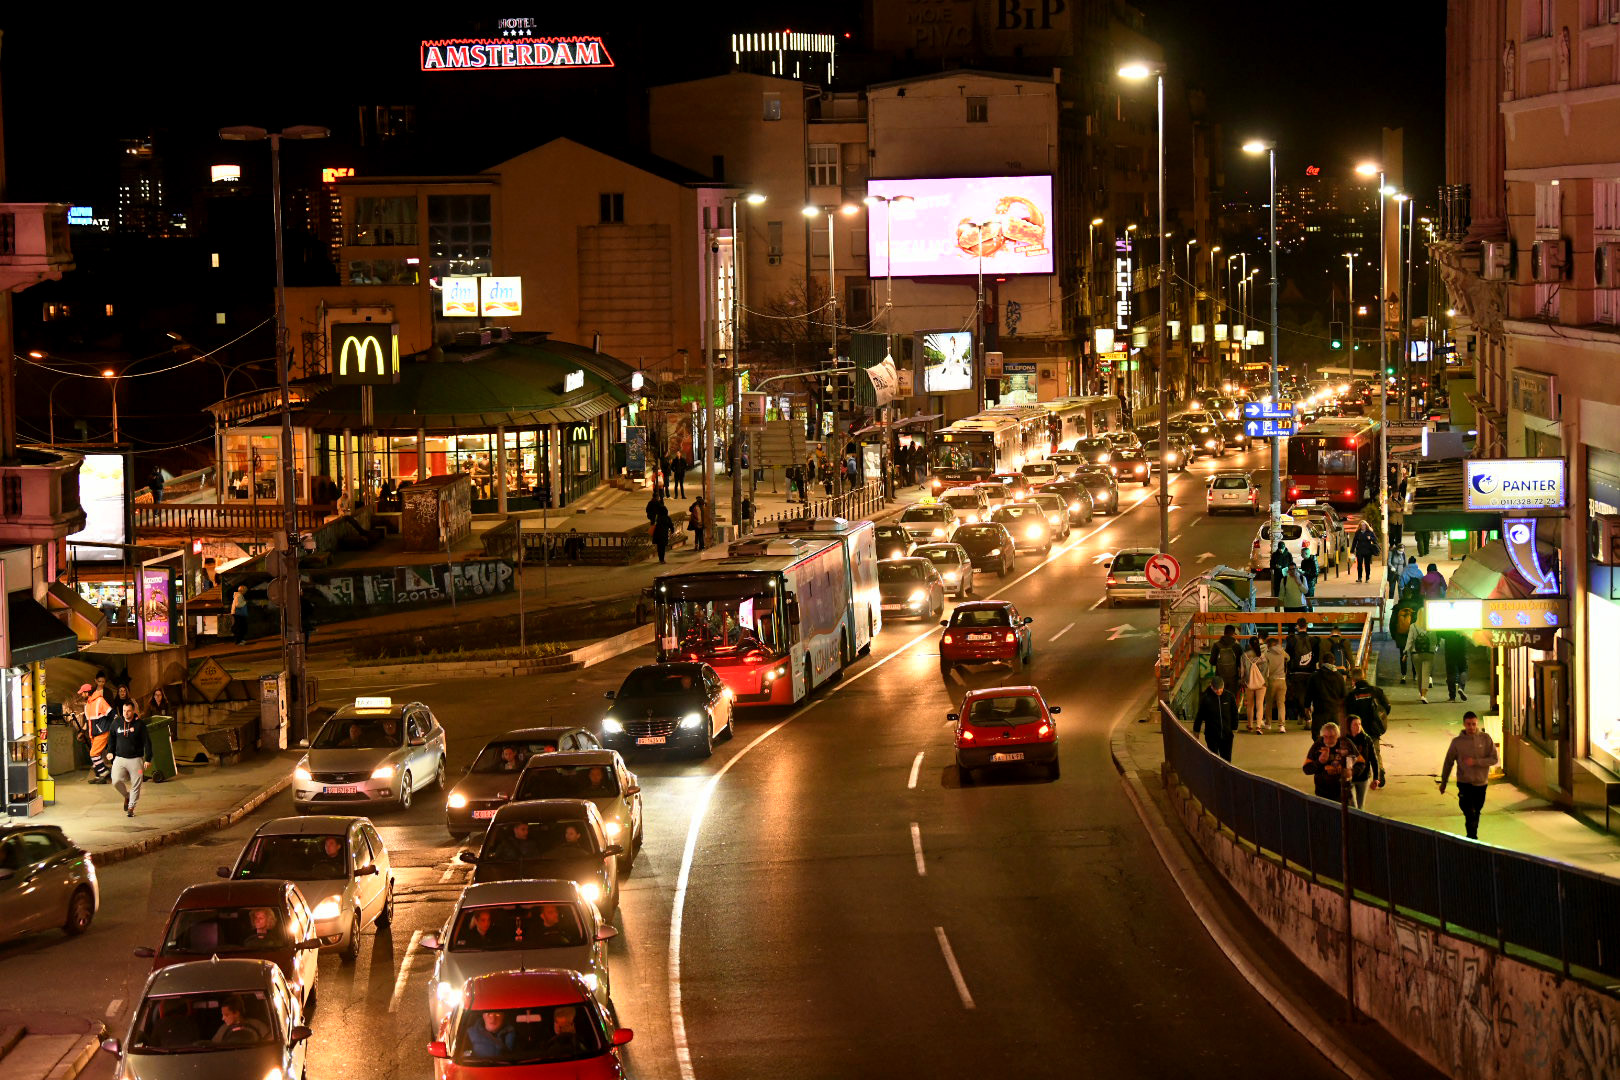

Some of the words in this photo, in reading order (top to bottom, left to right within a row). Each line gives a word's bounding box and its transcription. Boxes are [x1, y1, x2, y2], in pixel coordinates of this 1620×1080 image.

[498, 18, 537, 29] HOTEL
[425, 42, 601, 68] AMSTERDAM
[451, 282, 471, 299] dm
[490, 282, 513, 299] dm
[1117, 258, 1132, 330] HOTEL
[1502, 480, 1556, 491] PANTER
[1491, 632, 1541, 644] ЗЛАТАР
